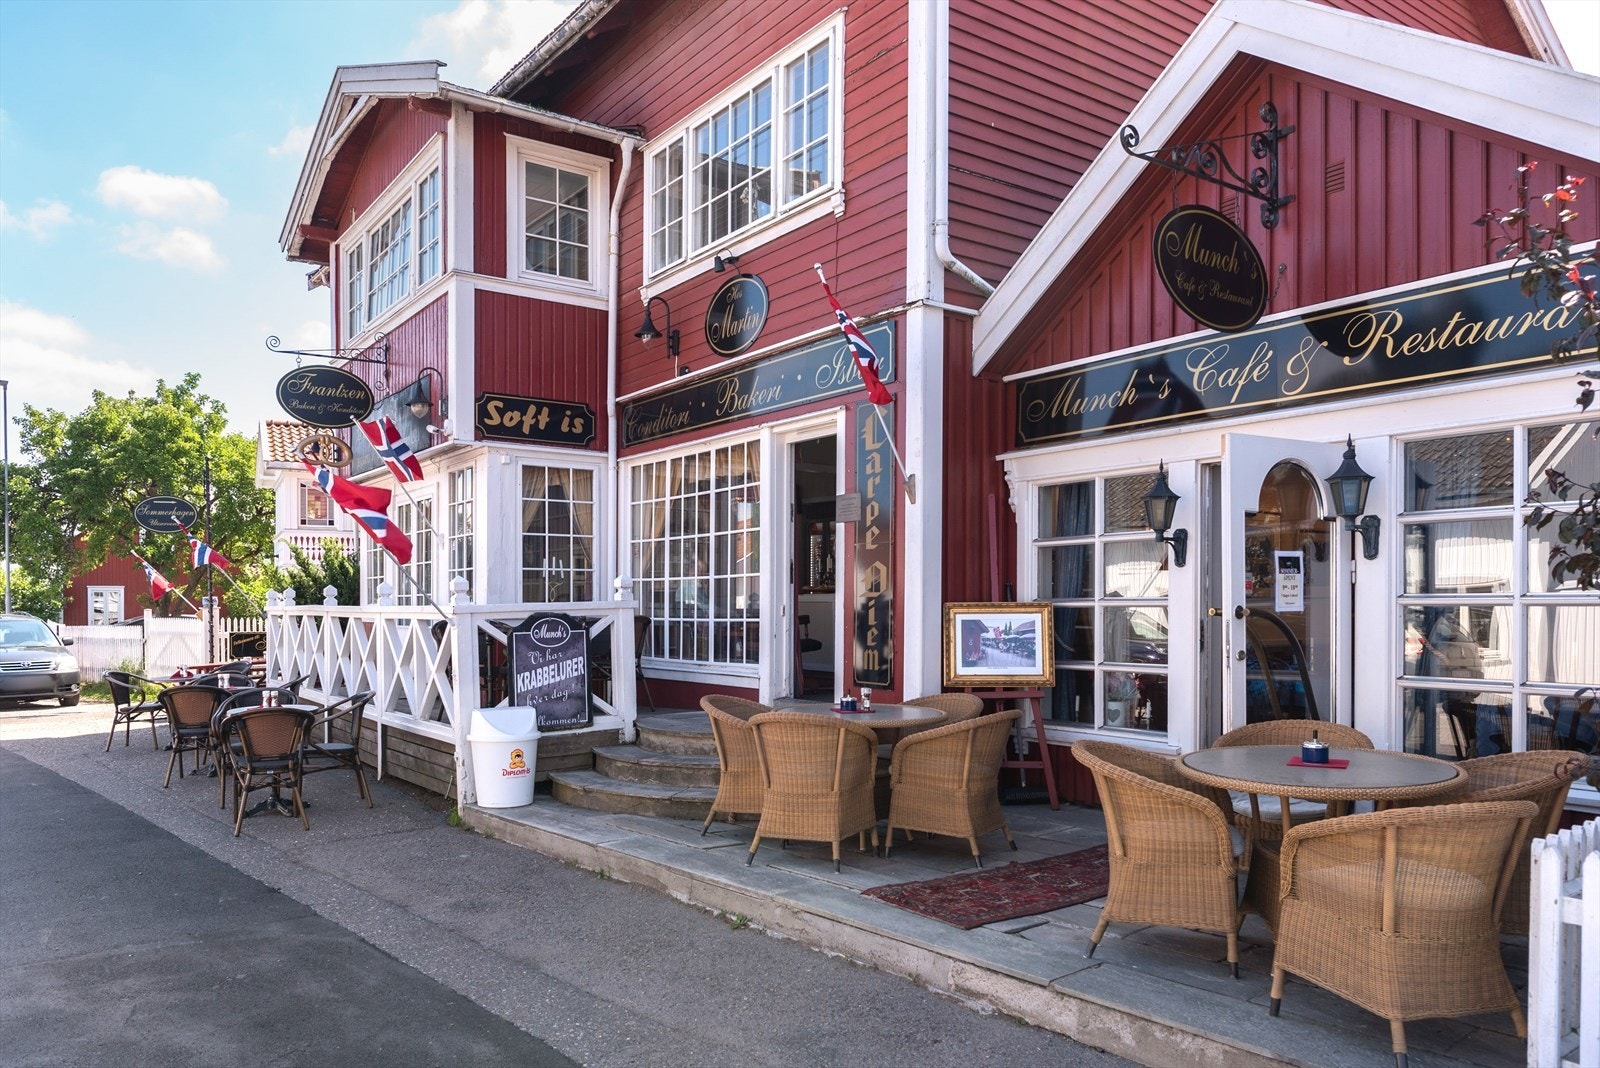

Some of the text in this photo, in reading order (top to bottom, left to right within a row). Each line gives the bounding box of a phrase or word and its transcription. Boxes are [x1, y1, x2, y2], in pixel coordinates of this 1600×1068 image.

[1198, 281, 1207, 301] &
[1209, 279, 1254, 306] Restaurant
[711, 303, 760, 343] Martin
[1185, 340, 1274, 404] Café
[1281, 335, 1329, 396] &
[1342, 303, 1583, 366] Restaura
[287, 372, 366, 400] Frantzen
[716, 373, 784, 417] Bakeri
[288, 398, 316, 411] Bakeri
[317, 403, 326, 414] &
[484, 400, 584, 435] Soft is
[137, 504, 195, 520] Sommerhagen
[859, 405, 888, 671] Carpe Diem
[533, 623, 567, 639] Munch's
[527, 648, 565, 665] Vi har
[517, 656, 584, 694] KRABBELURER
[526, 693, 549, 706] hver
[537, 714, 580, 727] lkommen!
